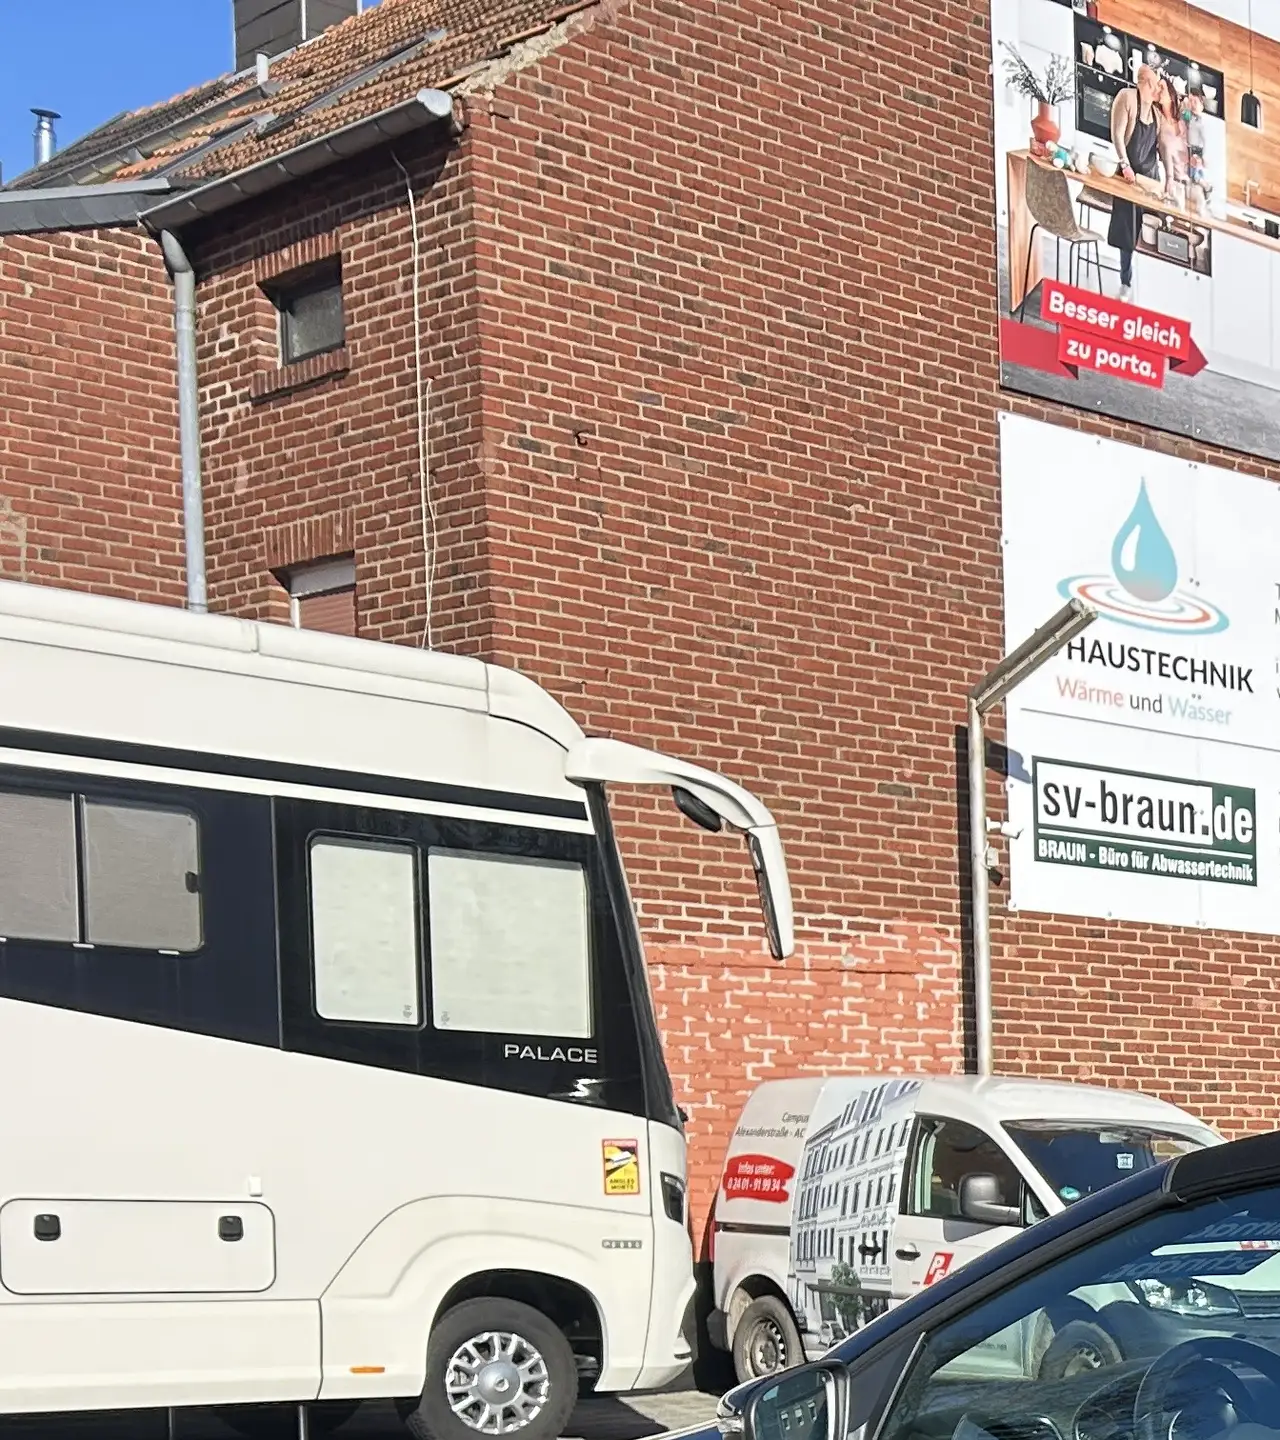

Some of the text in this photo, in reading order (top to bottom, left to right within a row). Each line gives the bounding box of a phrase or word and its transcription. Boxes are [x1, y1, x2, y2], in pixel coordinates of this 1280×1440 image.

[1049, 290, 1181, 349] Besser gleich
[1066, 339, 1157, 379] zu porta.
[1067, 637, 1254, 694] HAUSTECHNIK
[1056, 675, 1232, 725] Wärme und Wasser
[1043, 780, 1253, 843] sv-braun.de
[1038, 839, 1086, 863] BRAUN
[1099, 846, 1128, 868] Büro
[1131, 851, 1149, 870] für
[1152, 853, 1254, 882] Abwassertechnik
[504, 1043, 598, 1064] PALACE
[735, 1126, 788, 1138] Alexanderstraße
